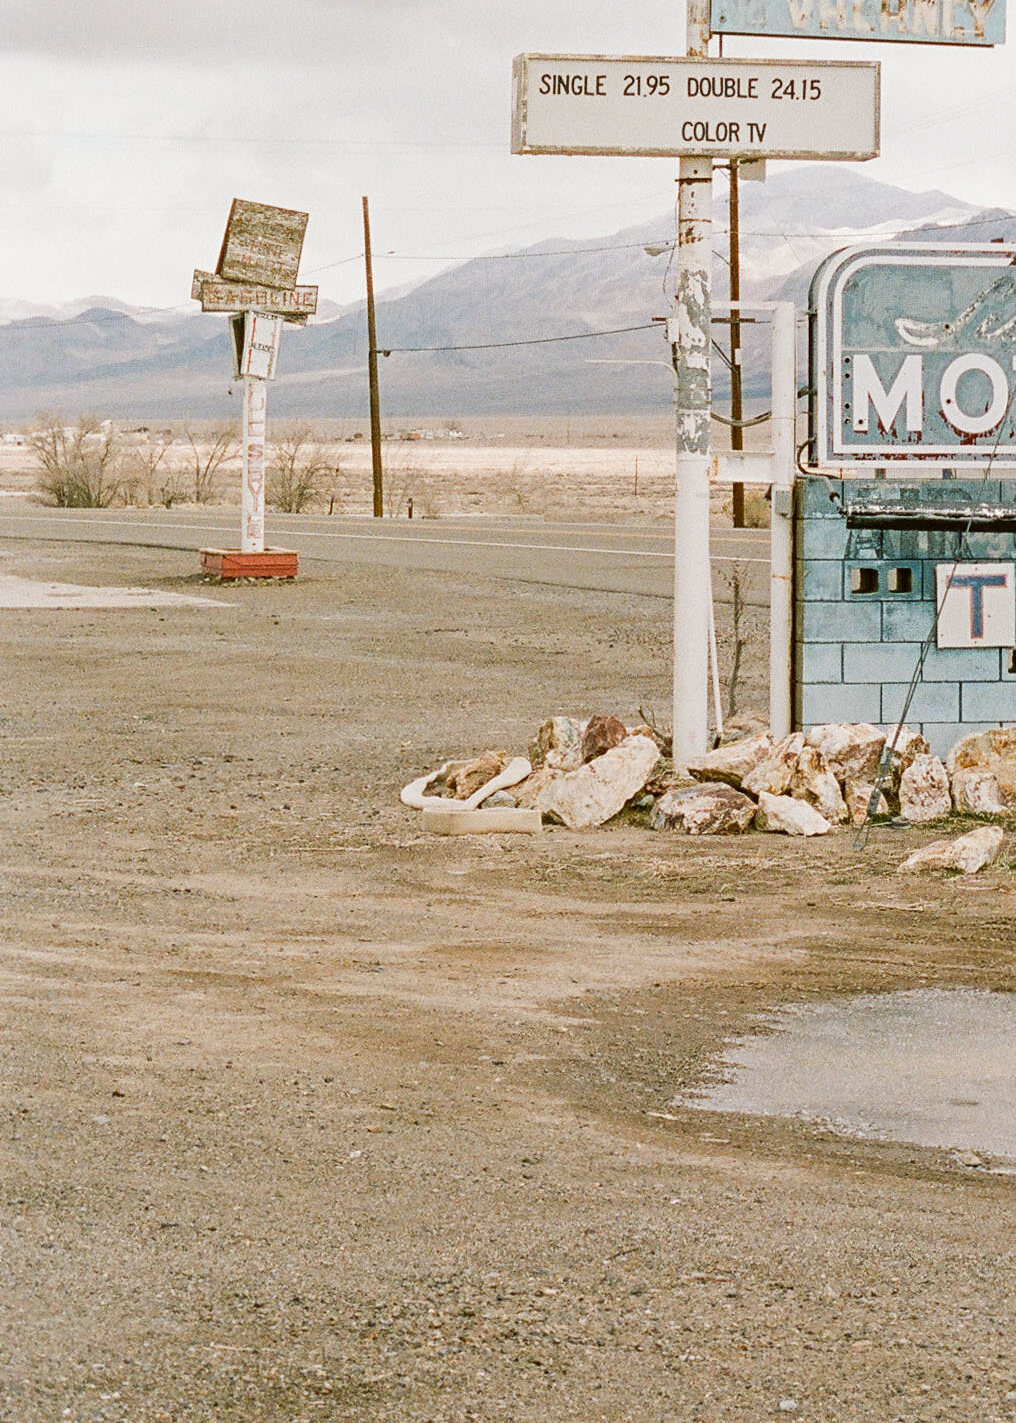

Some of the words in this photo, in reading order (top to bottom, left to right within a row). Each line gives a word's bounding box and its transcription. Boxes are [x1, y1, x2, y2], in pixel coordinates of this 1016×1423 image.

[538, 73, 608, 96] SINGLE
[623, 75, 671, 97] 21.95
[686, 77, 759, 99] DOUBLE
[770, 78, 822, 101] 24.15
[681, 121, 740, 142] COLOR
[747, 122, 768, 143] TV
[207, 288, 314, 307] GASOLINE
